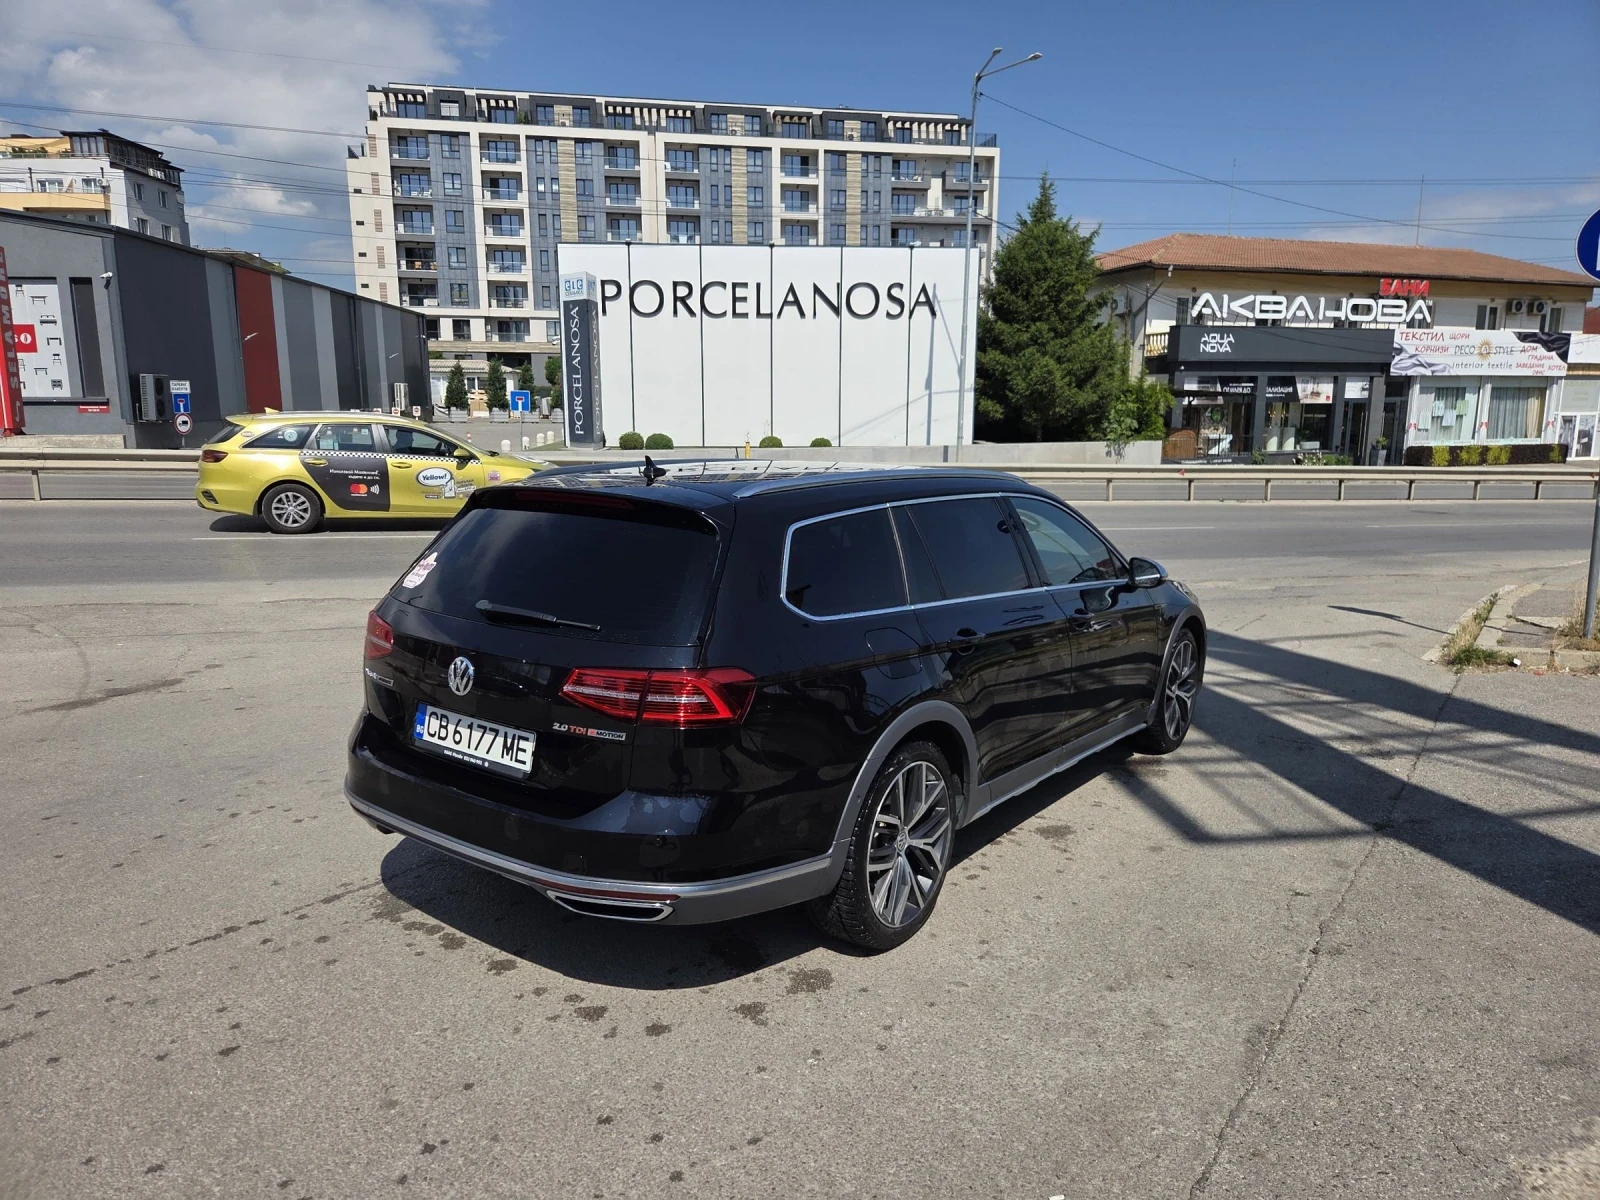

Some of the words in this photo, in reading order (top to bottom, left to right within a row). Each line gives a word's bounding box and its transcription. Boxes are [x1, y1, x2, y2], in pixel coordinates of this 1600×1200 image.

[1380, 278, 1429, 296] БАНИ
[600, 279, 937, 320] PORCELANOSA
[1191, 292, 1432, 324] АКВАНОВА
[1200, 332, 1235, 343] AQUA
[1399, 331, 1445, 342] ТЕКСТИЛ
[1449, 332, 1470, 340] ЩОРИ
[1200, 342, 1232, 353] NOVA
[1414, 344, 1449, 354] КОРНИЗИ
[1454, 344, 1476, 355] DECO
[1493, 345, 1514, 355] STYLE
[1520, 345, 1538, 354] ДОМ
[570, 305, 585, 435] PORCELANOSA
[1453, 361, 1484, 369] interior
[1487, 361, 1513, 370] textile
[422, 473, 447, 481] Yellow!
[416, 724, 424, 734] BG
[552, 722, 569, 731] 2.0
[569, 725, 587, 735] TDI
[452, 718, 500, 755] 6177
